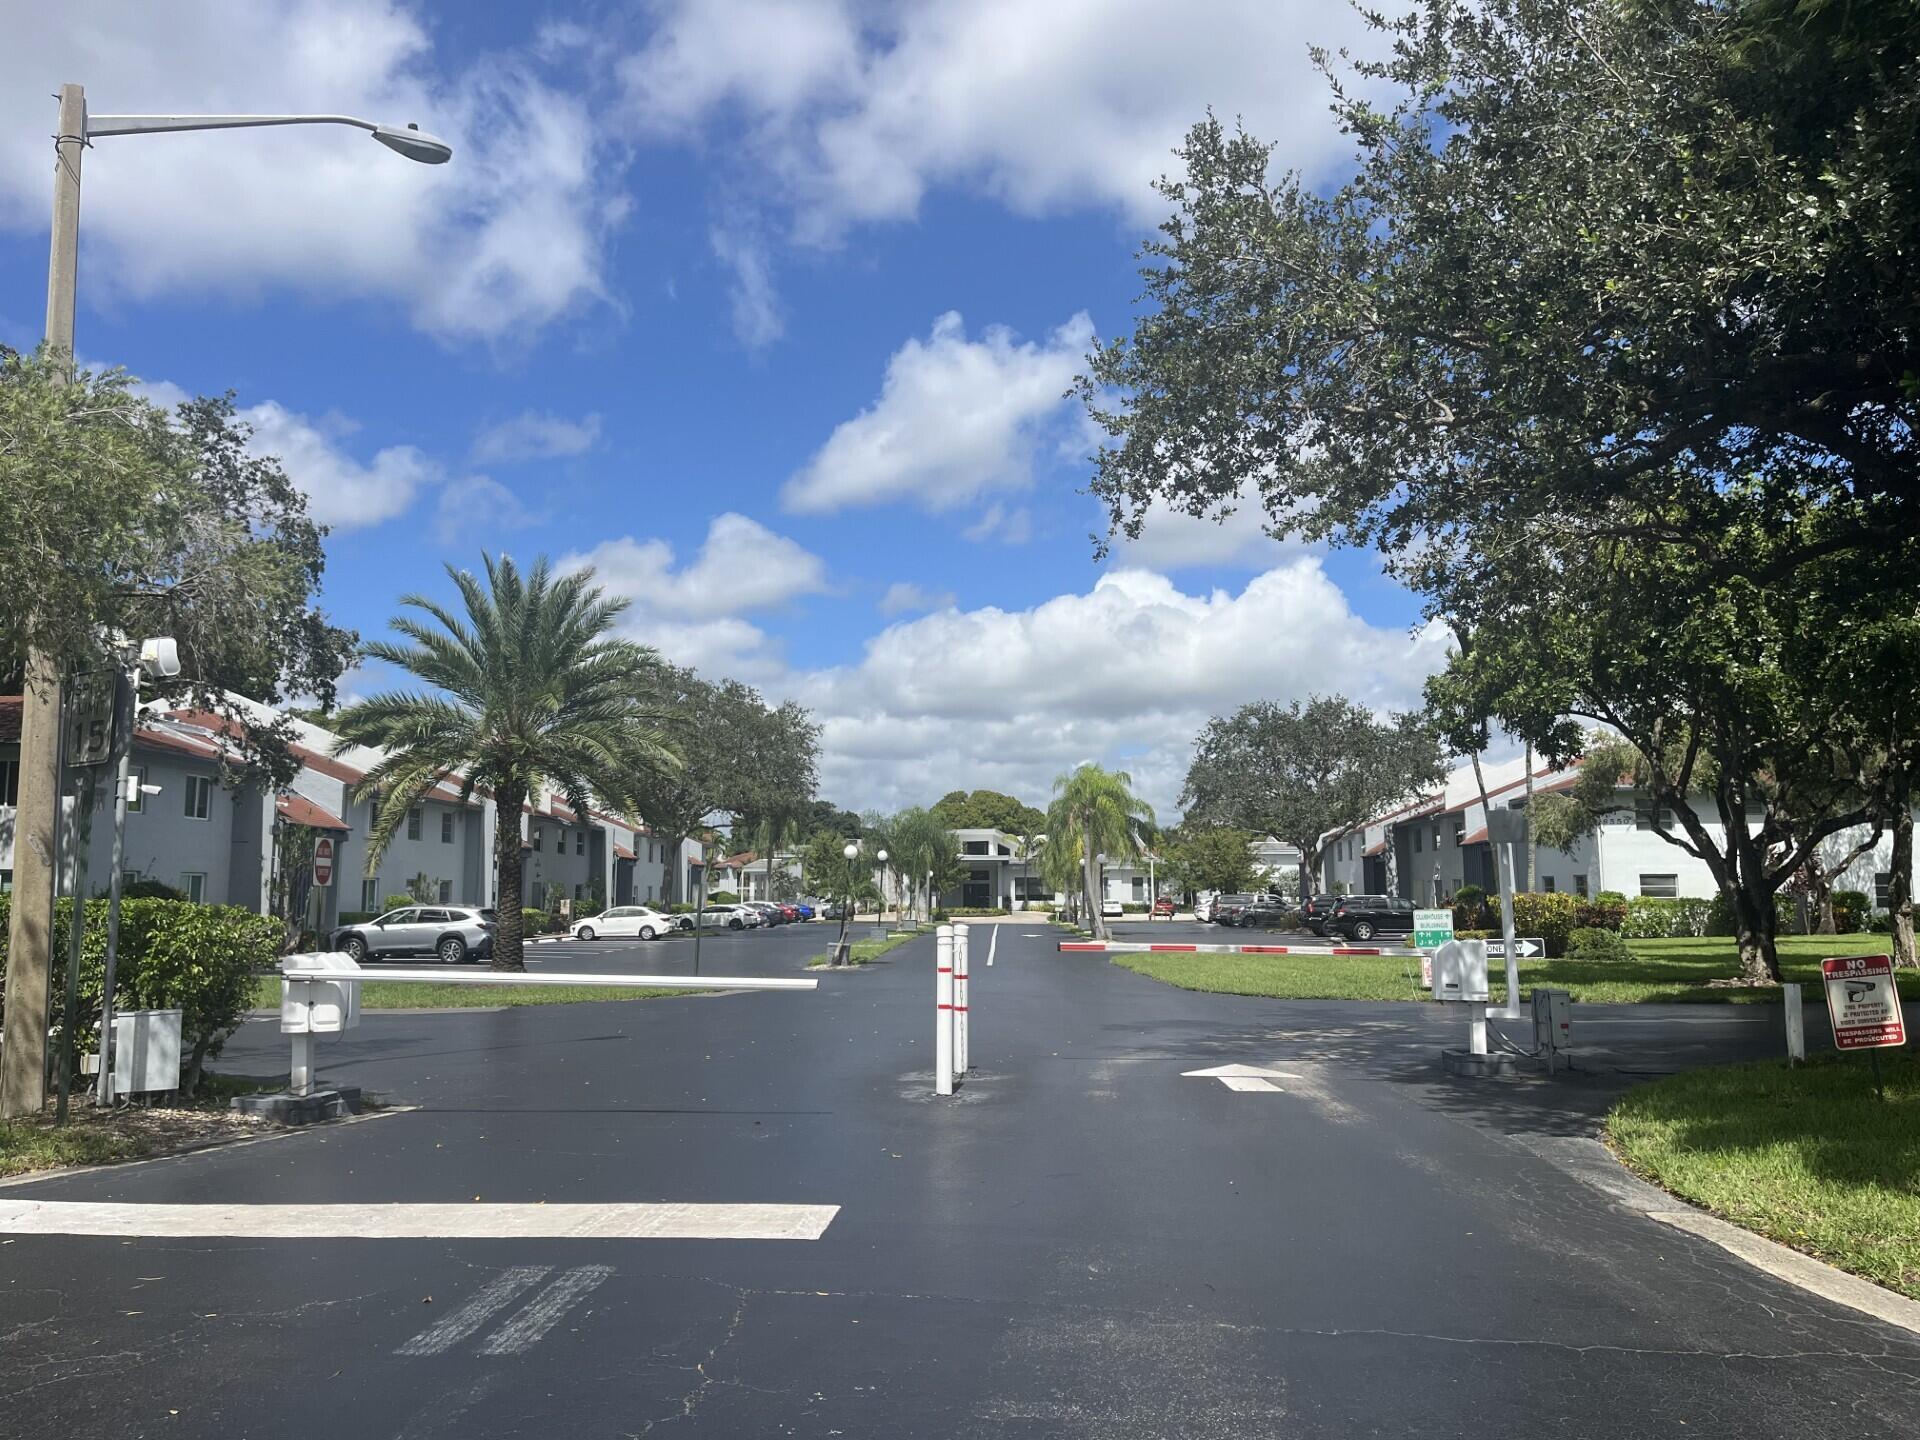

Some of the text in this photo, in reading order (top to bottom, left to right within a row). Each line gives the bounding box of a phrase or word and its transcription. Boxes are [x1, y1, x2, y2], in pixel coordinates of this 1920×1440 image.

[76, 720, 104, 753] 15
[1487, 945, 1503, 953] ONE
[1846, 960, 1866, 969] NO
[1826, 967, 1889, 979] TRESPASSING
[1850, 1009, 1879, 1017] PROTECTED
[1857, 1016, 1893, 1024] SURVEILLANCE
[1855, 1035, 1897, 1043] PROSECUTED
